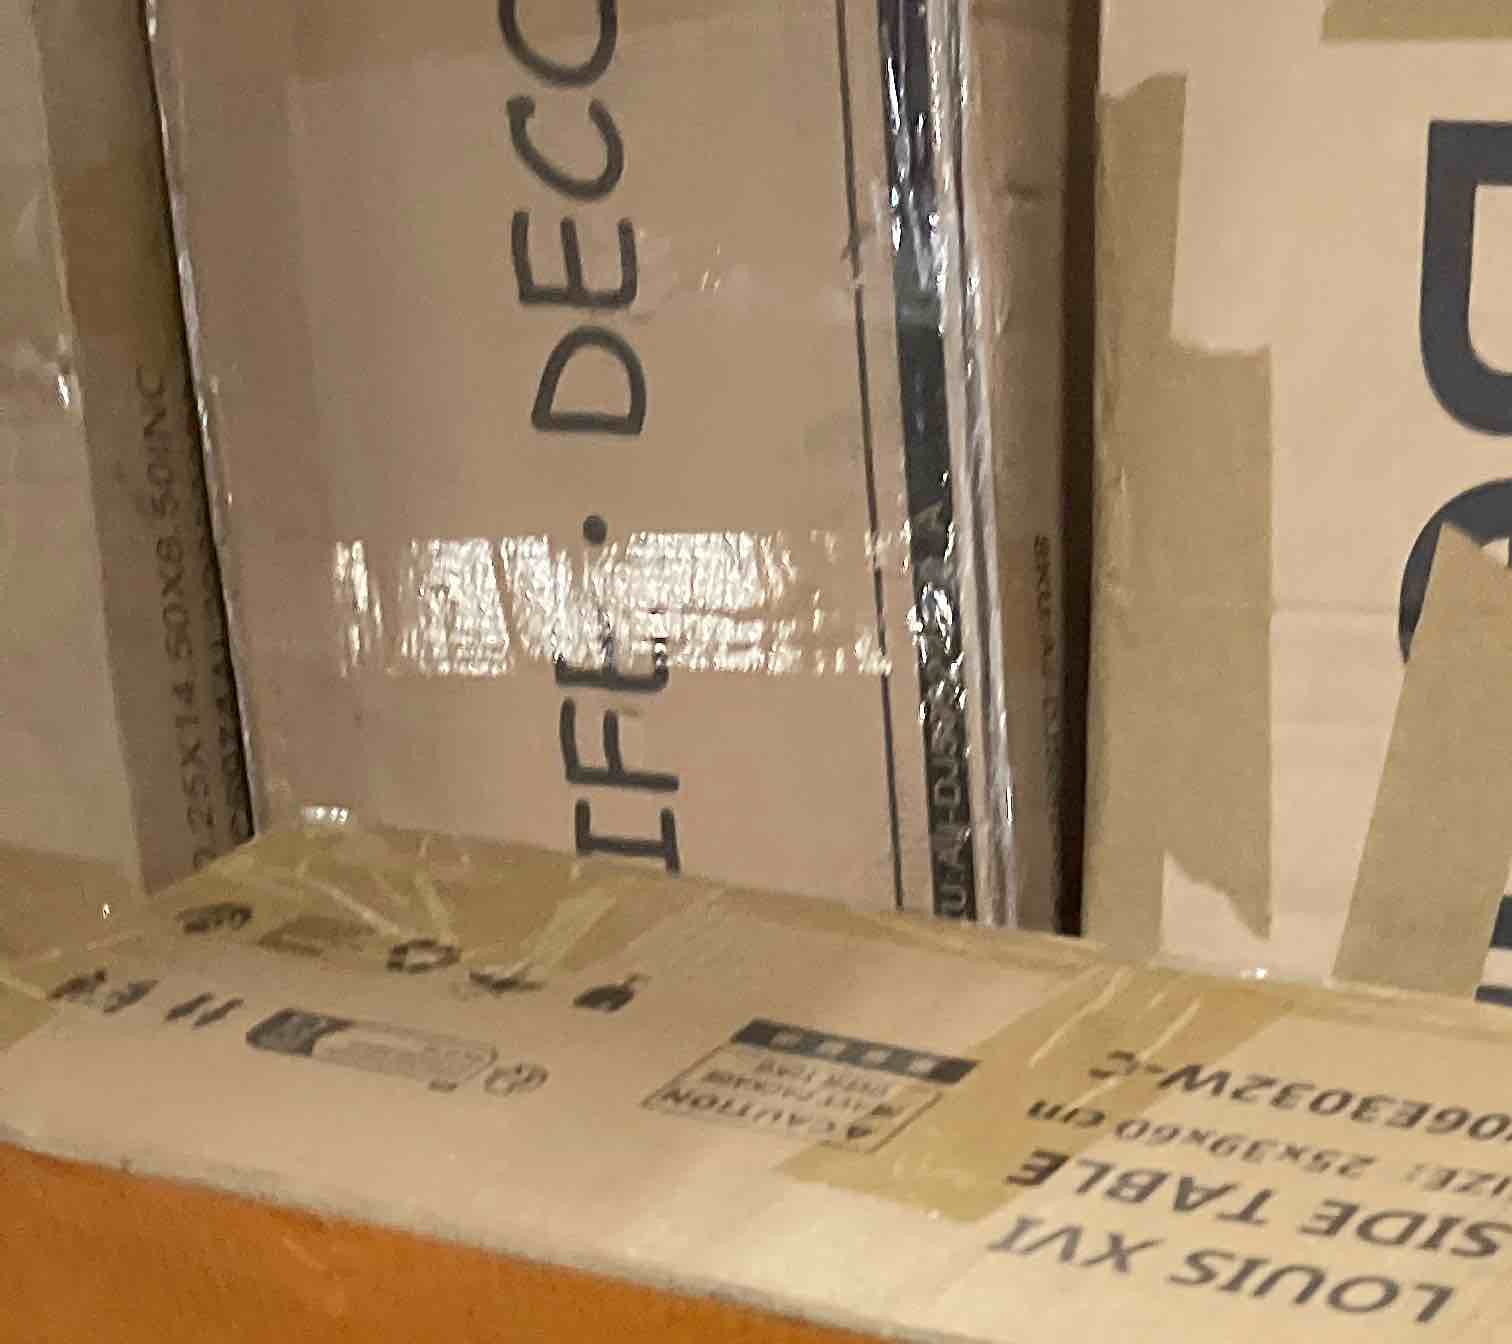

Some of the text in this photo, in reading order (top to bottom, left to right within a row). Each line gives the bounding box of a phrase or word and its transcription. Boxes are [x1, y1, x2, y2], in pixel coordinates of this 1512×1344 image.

[1026, 1099, 1107, 1130] cm
[1113, 1116, 1376, 1181] 25x39x60
[1005, 1148, 1277, 1226] TABLE
[985, 1216, 1456, 1324] LOUIS XVI
